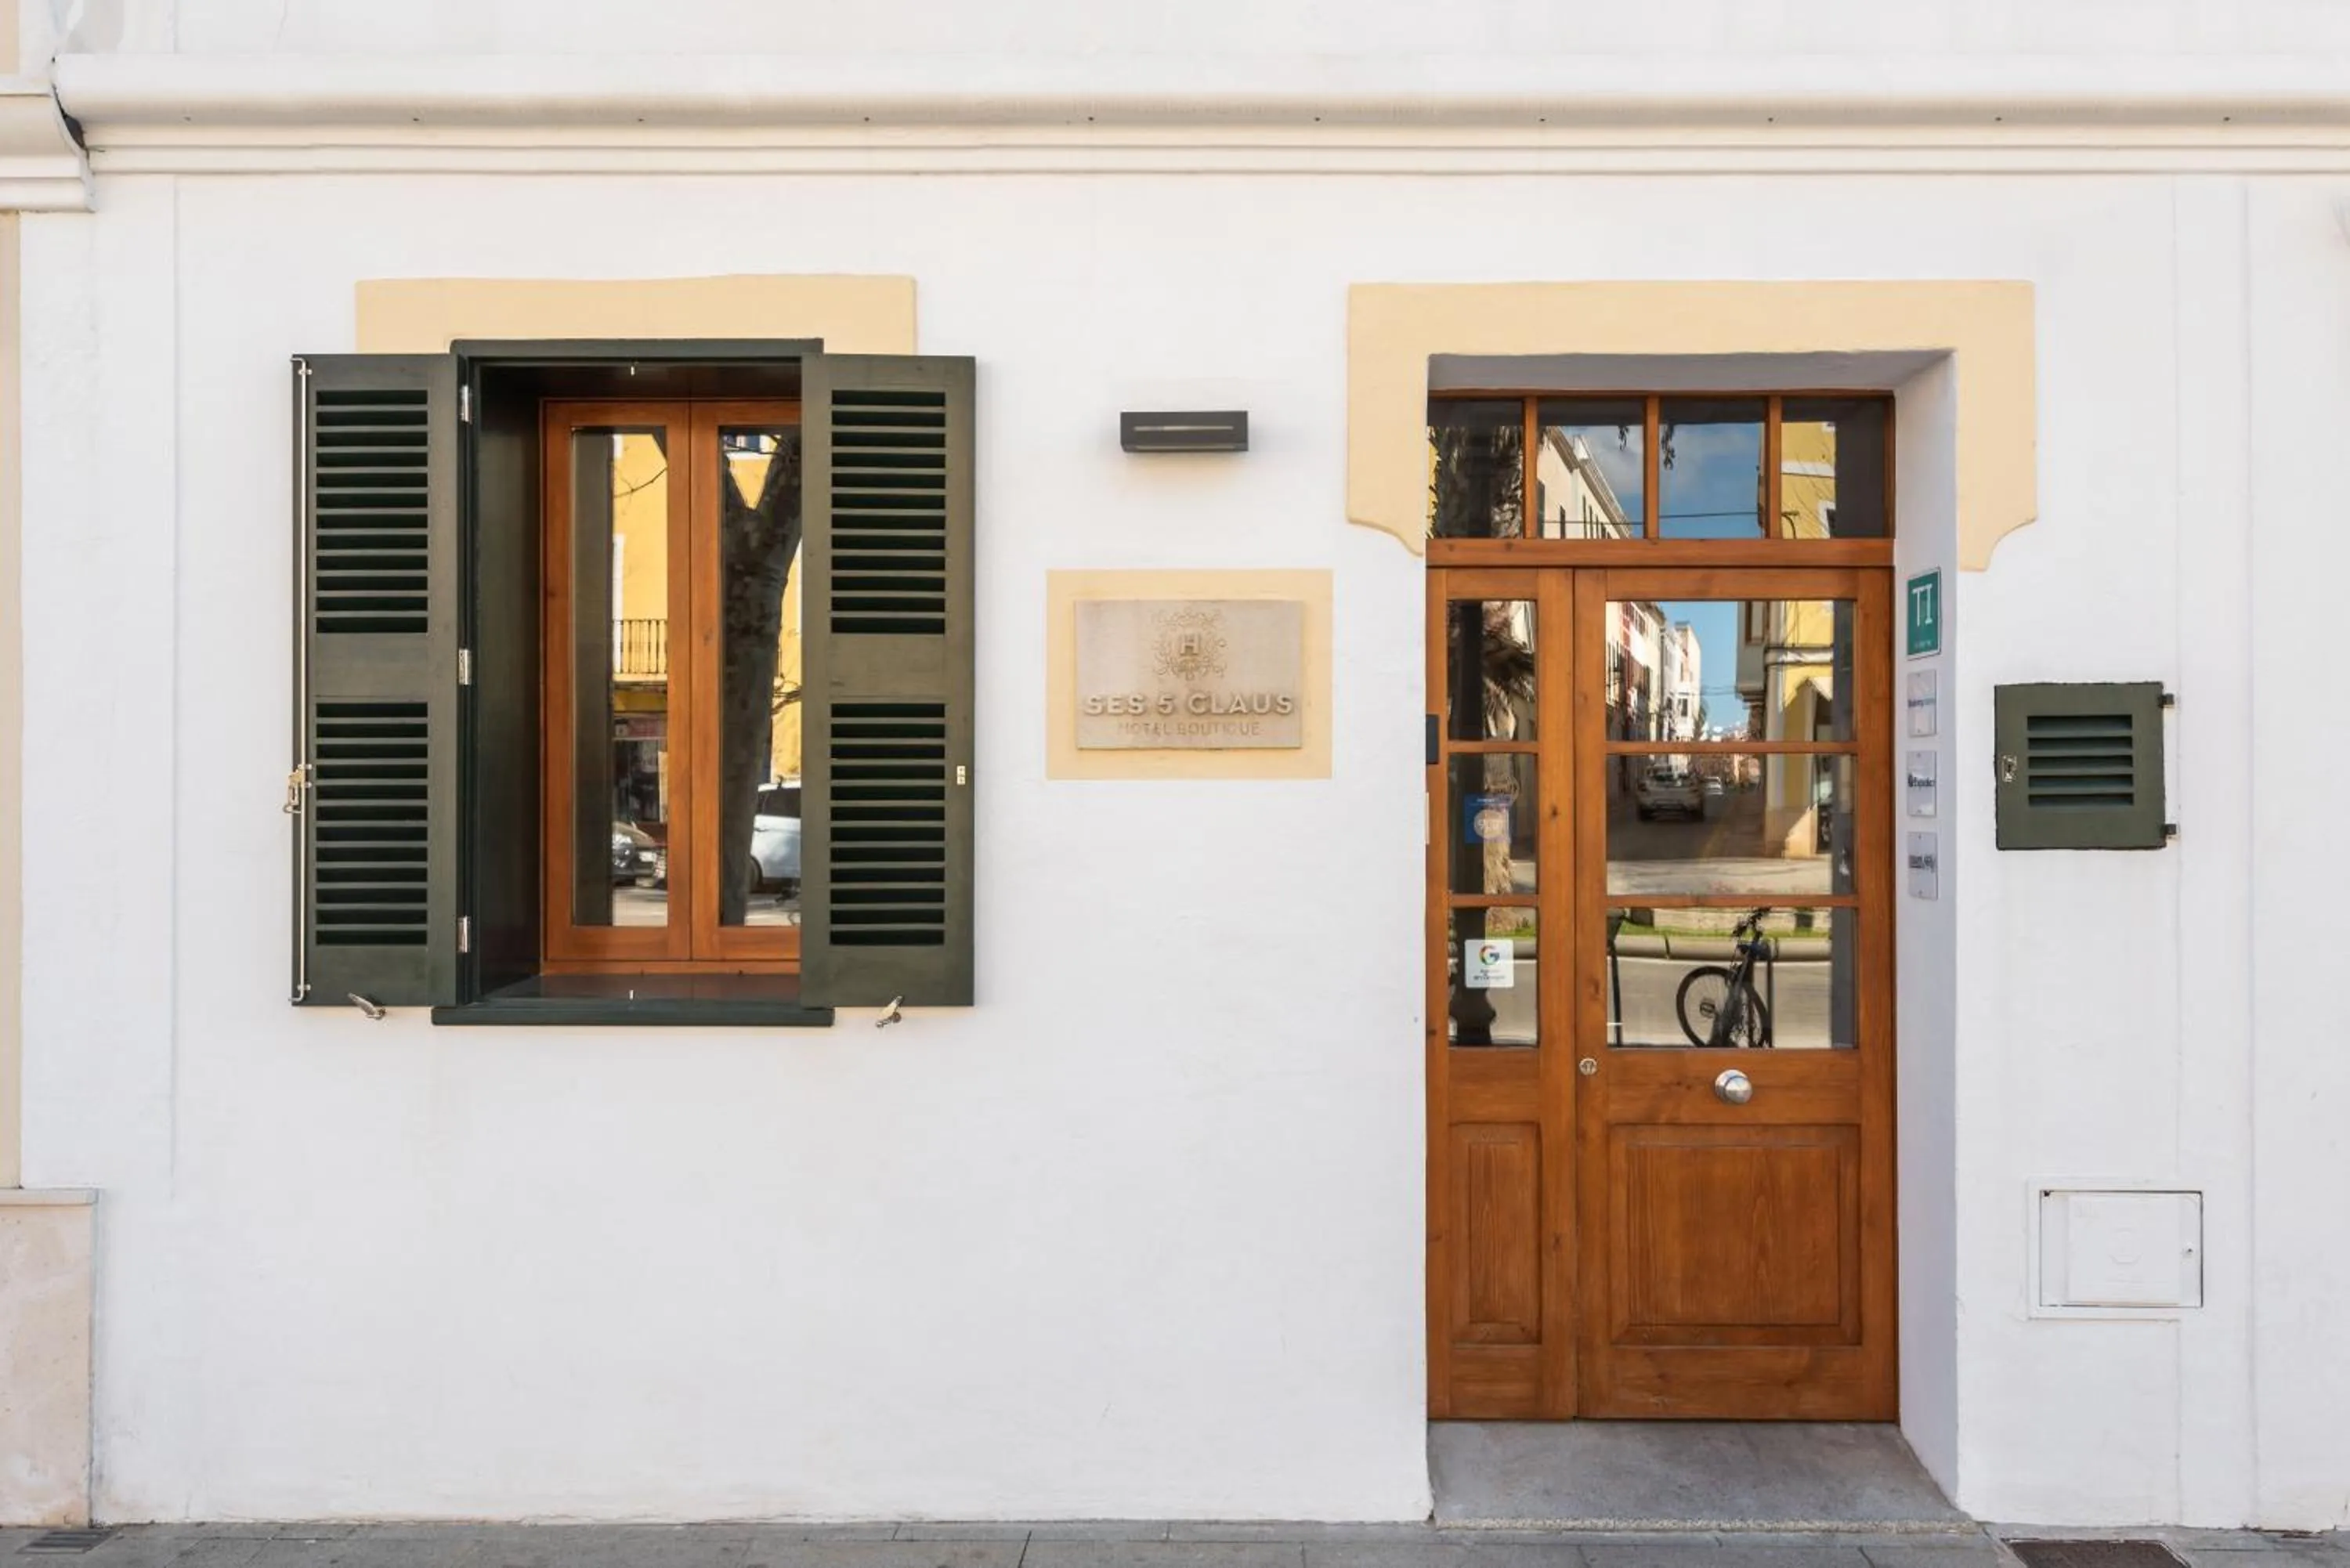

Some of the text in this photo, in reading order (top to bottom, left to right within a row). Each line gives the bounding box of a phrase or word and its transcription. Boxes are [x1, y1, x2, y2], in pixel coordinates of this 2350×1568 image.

[1180, 634, 1202, 656] H
[1085, 691, 1294, 715] SES 5 CLAUS
[1117, 721, 1260, 736] HOTEL BOUTIQUE
